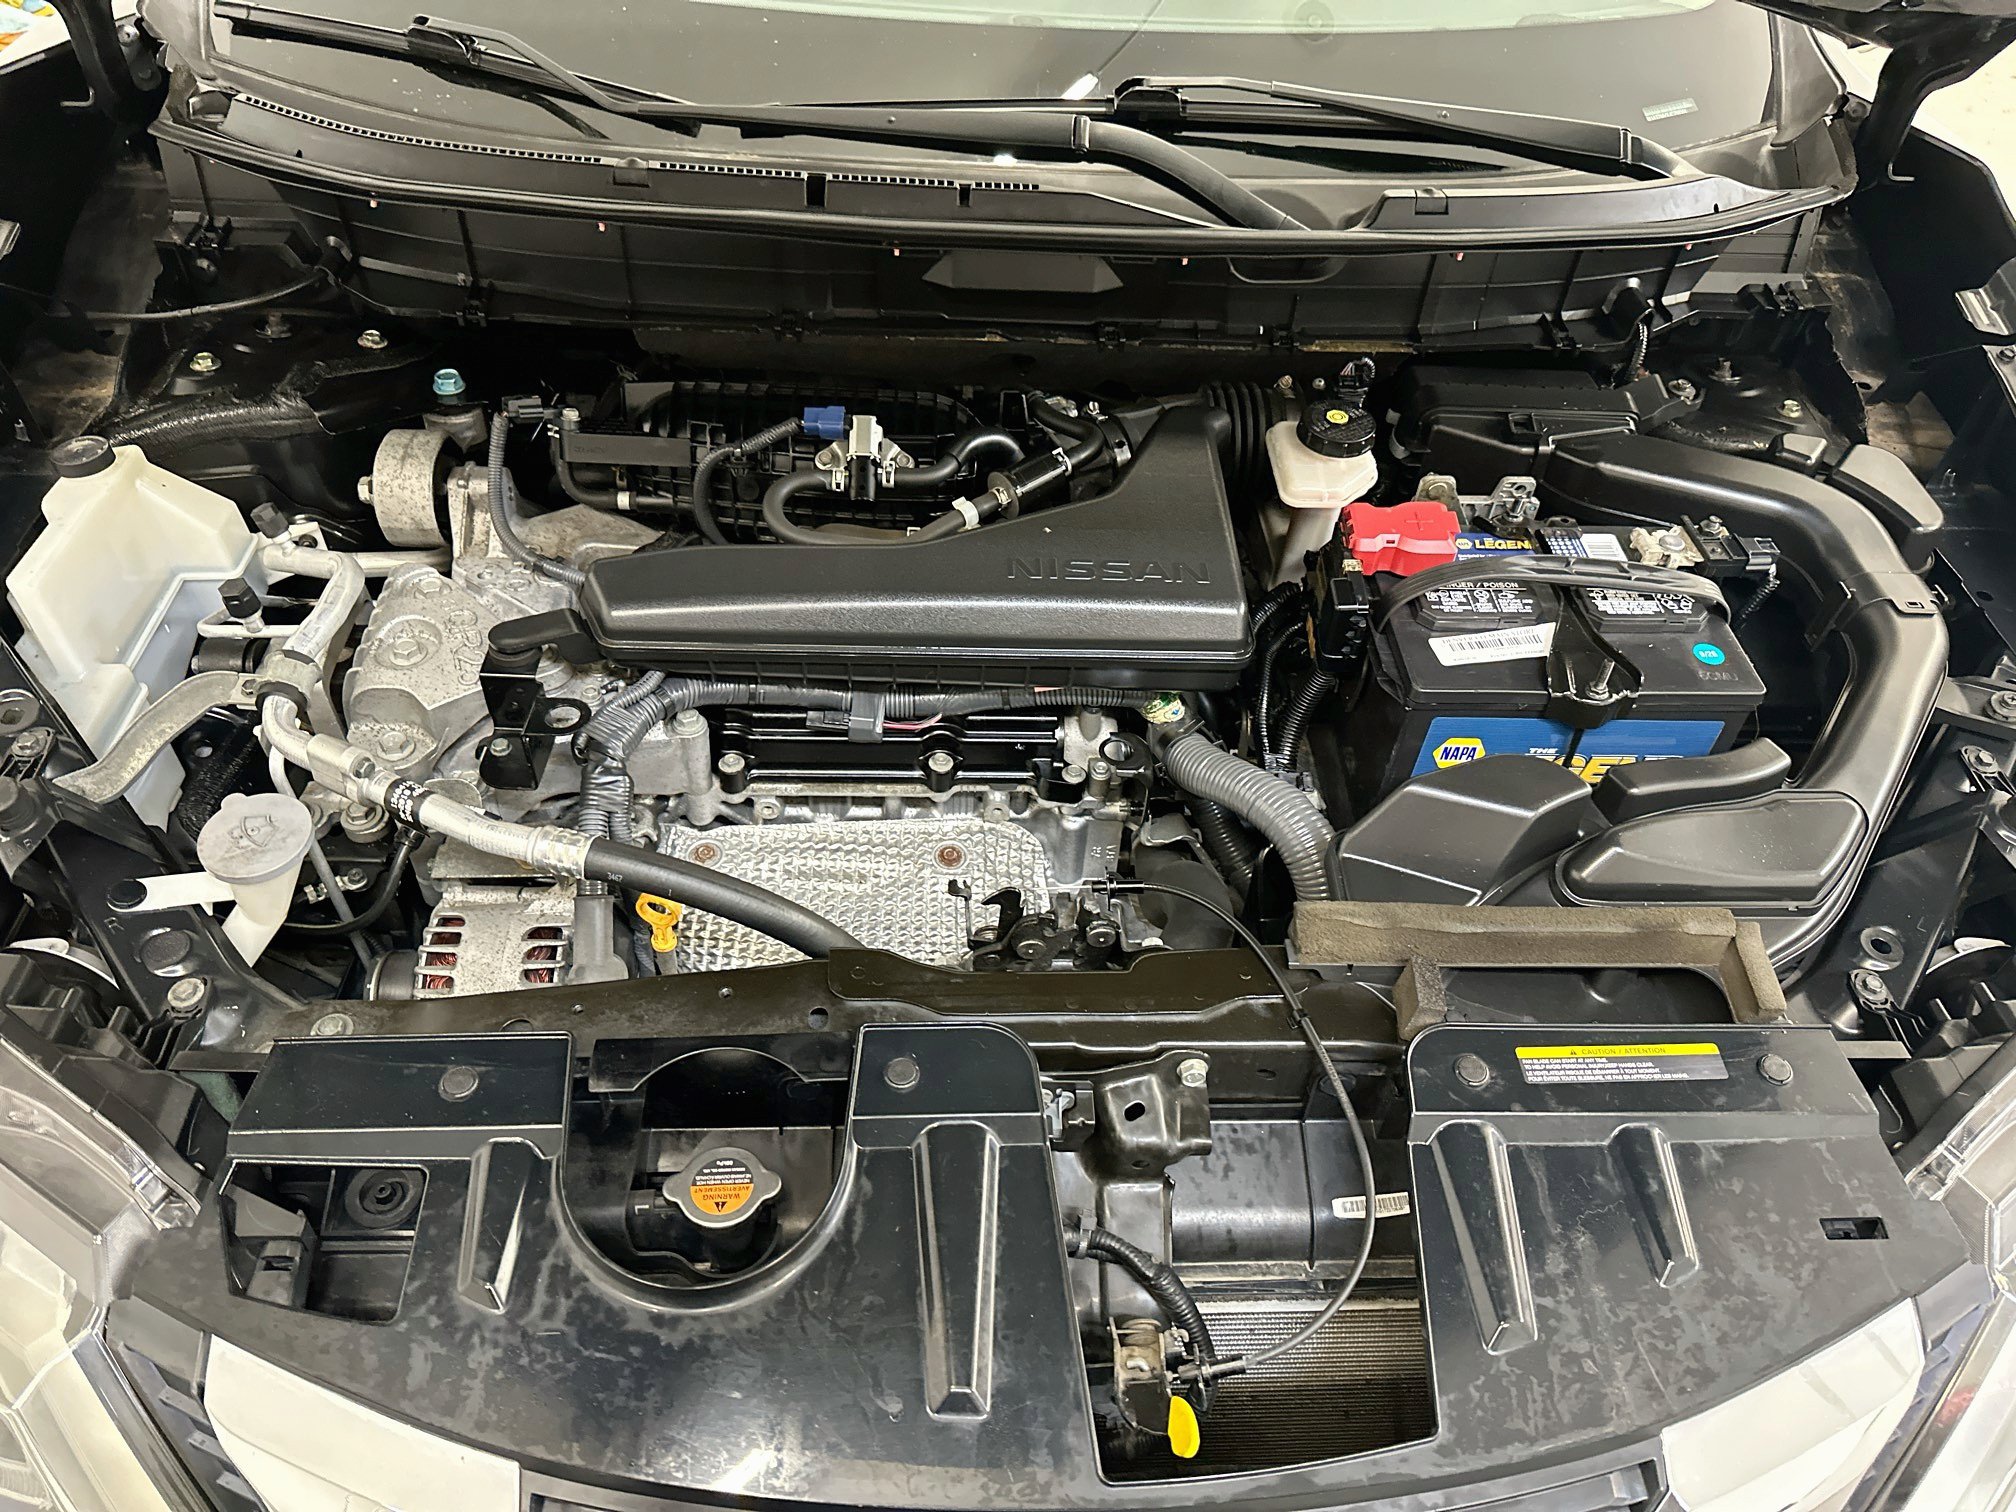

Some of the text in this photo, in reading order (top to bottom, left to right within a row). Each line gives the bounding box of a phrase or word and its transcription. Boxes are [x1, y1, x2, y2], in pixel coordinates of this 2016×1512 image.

[1475, 539, 1532, 550] LEGEN
[1008, 556, 1211, 584] NISSAN
[1439, 745, 1477, 761] NAPA
[694, 1185, 750, 1194] AVERTISSEMENT
[702, 1193, 741, 1201] WARNING
